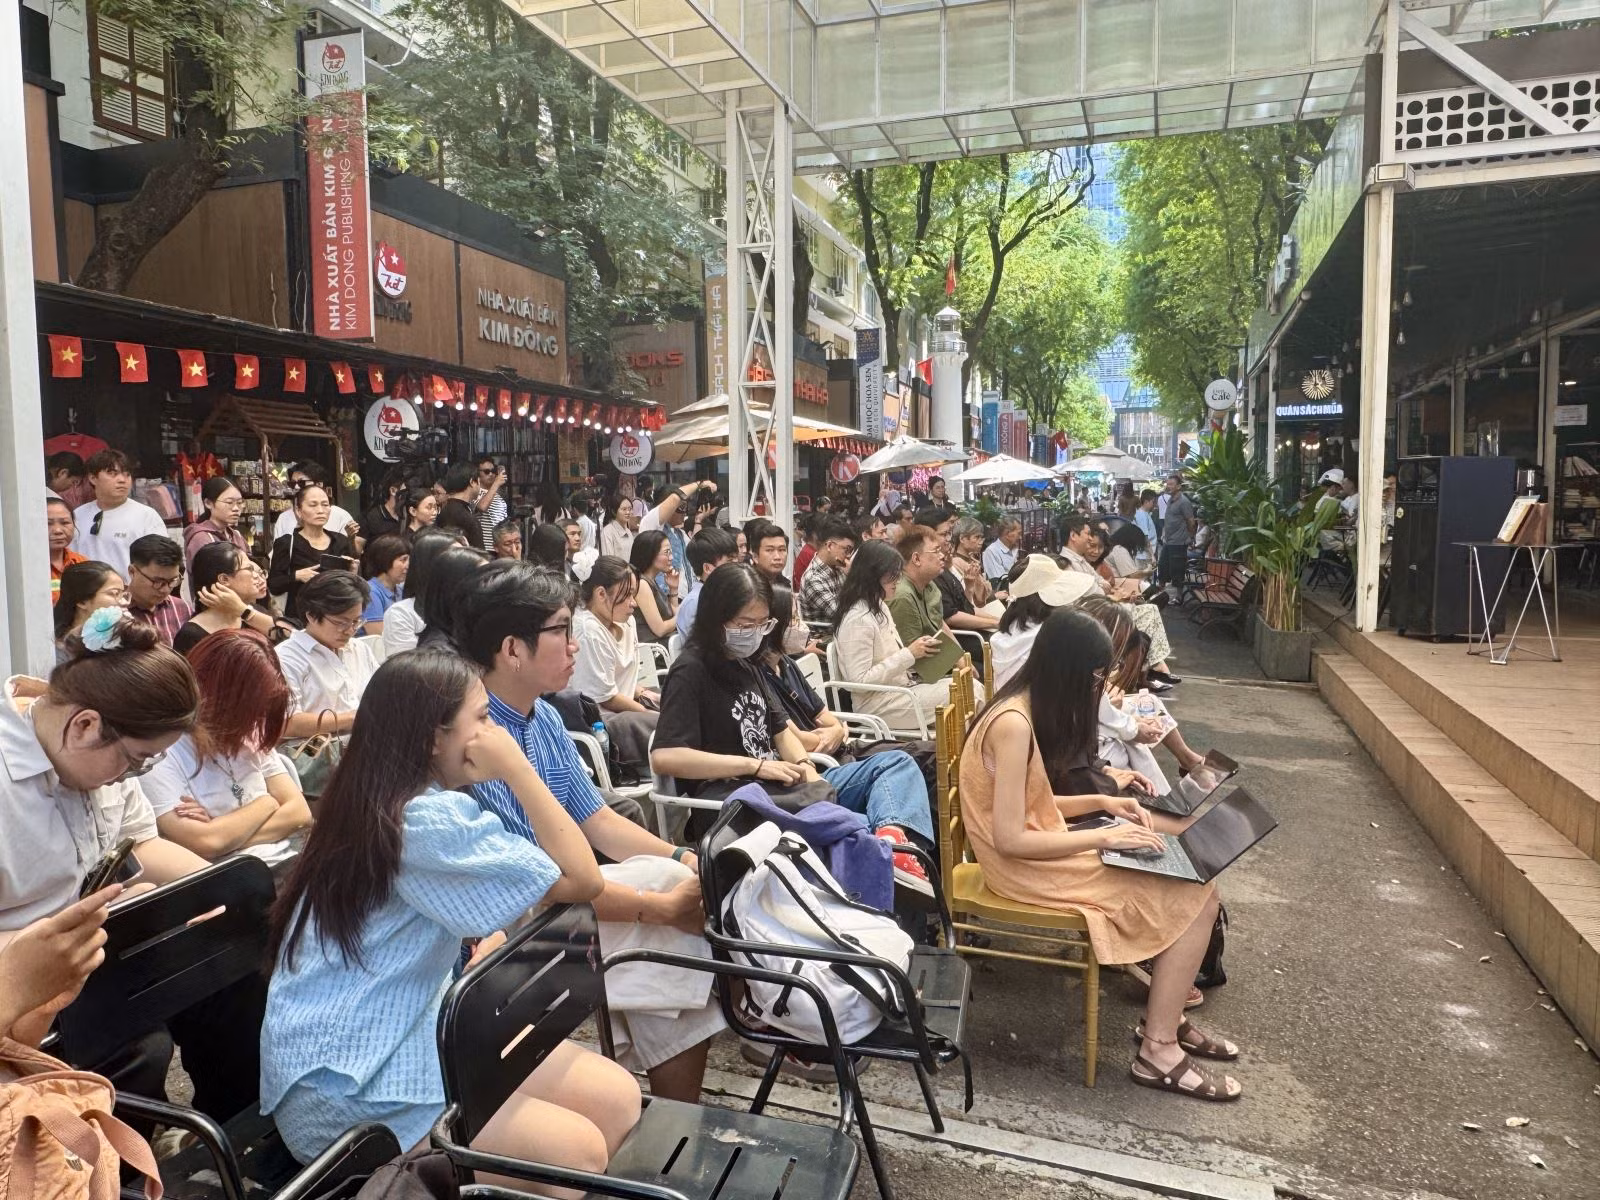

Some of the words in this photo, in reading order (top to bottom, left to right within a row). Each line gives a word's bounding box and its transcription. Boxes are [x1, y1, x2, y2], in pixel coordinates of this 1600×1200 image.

[323, 164, 336, 197] KIM
[340, 158, 355, 244] PUBLISHING
[322, 202, 337, 238] BẢN
[322, 244, 339, 288] XUẤT
[342, 249, 356, 299] DONG
[326, 292, 340, 331] NHÀ
[342, 303, 357, 330] KIM
[479, 317, 511, 345] KIM
